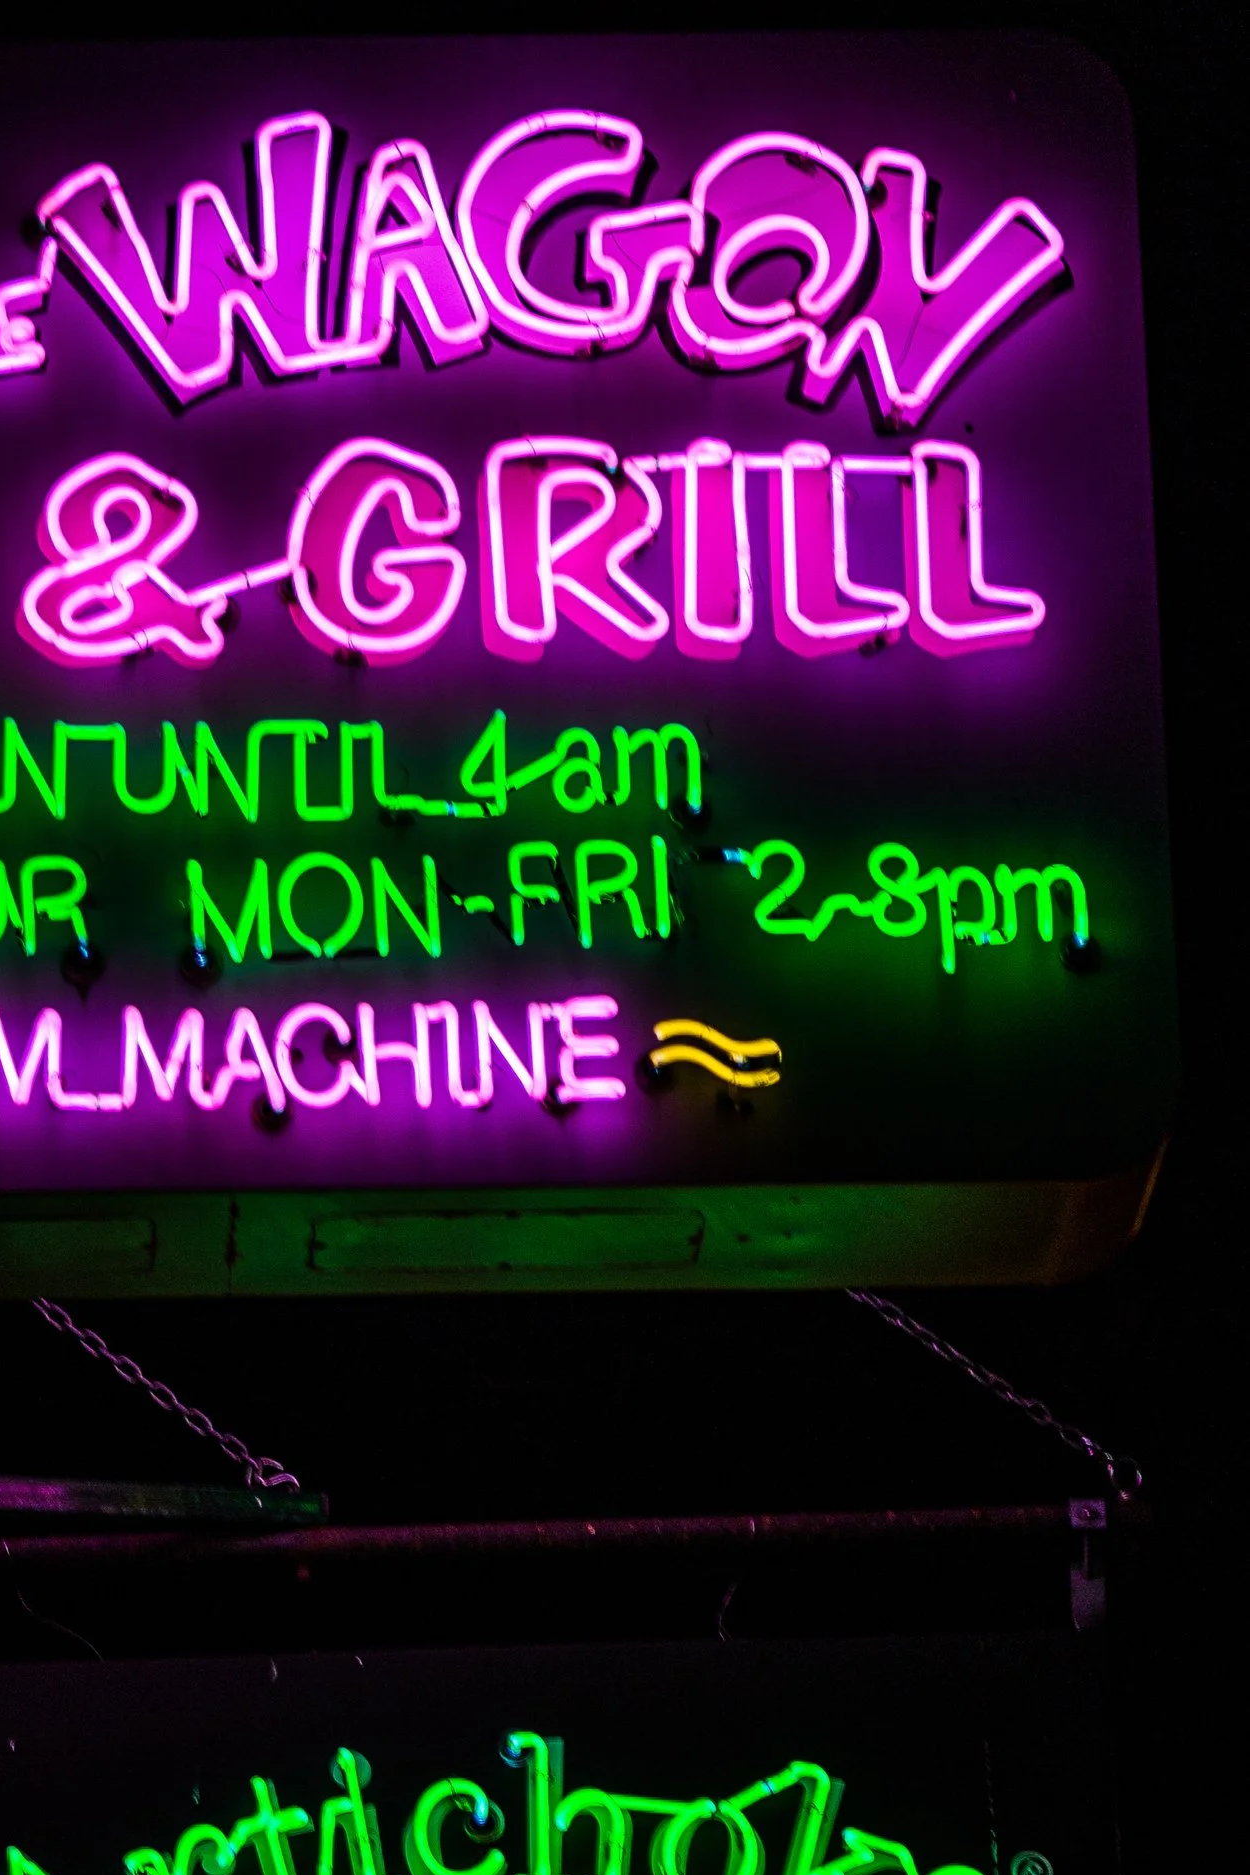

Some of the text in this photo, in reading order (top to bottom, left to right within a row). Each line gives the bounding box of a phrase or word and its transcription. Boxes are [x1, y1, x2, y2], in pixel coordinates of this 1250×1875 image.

[40, 108, 1068, 425] WAGON
[18, 450, 222, 668] &
[285, 436, 1046, 662] GRILL
[113, 718, 428, 824] UNTIL
[460, 708, 702, 814] 4am
[122, 994, 627, 1112] MACHINE
